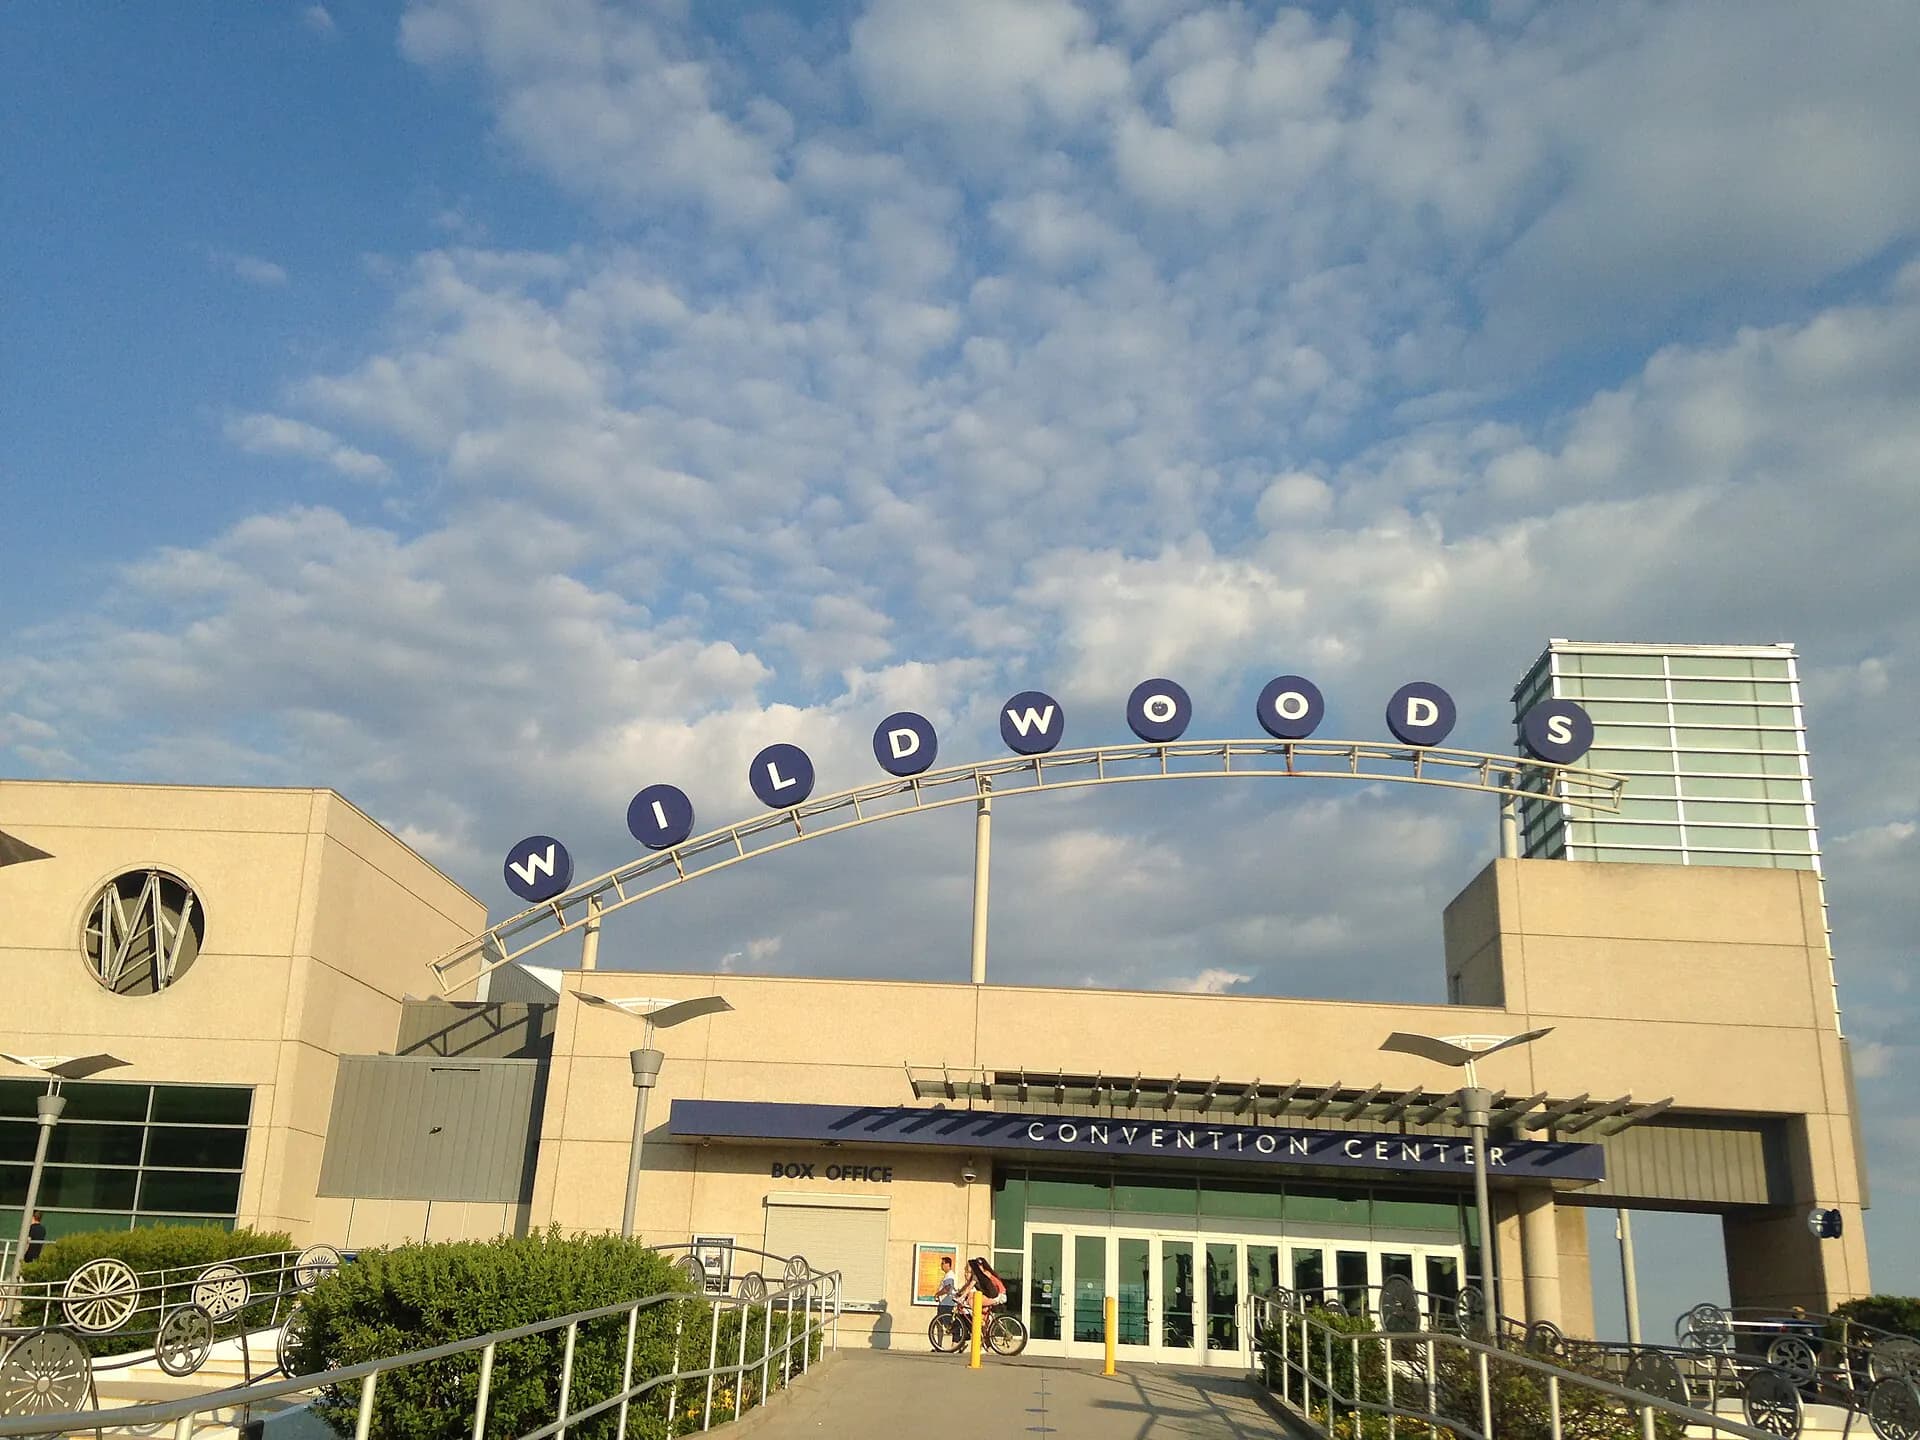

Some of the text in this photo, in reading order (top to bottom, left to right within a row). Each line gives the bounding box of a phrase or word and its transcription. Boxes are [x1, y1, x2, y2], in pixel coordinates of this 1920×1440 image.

[1027, 1122, 1507, 1167] CONVENTION CENTER
[771, 1162, 893, 1183] BOX OFFICE
